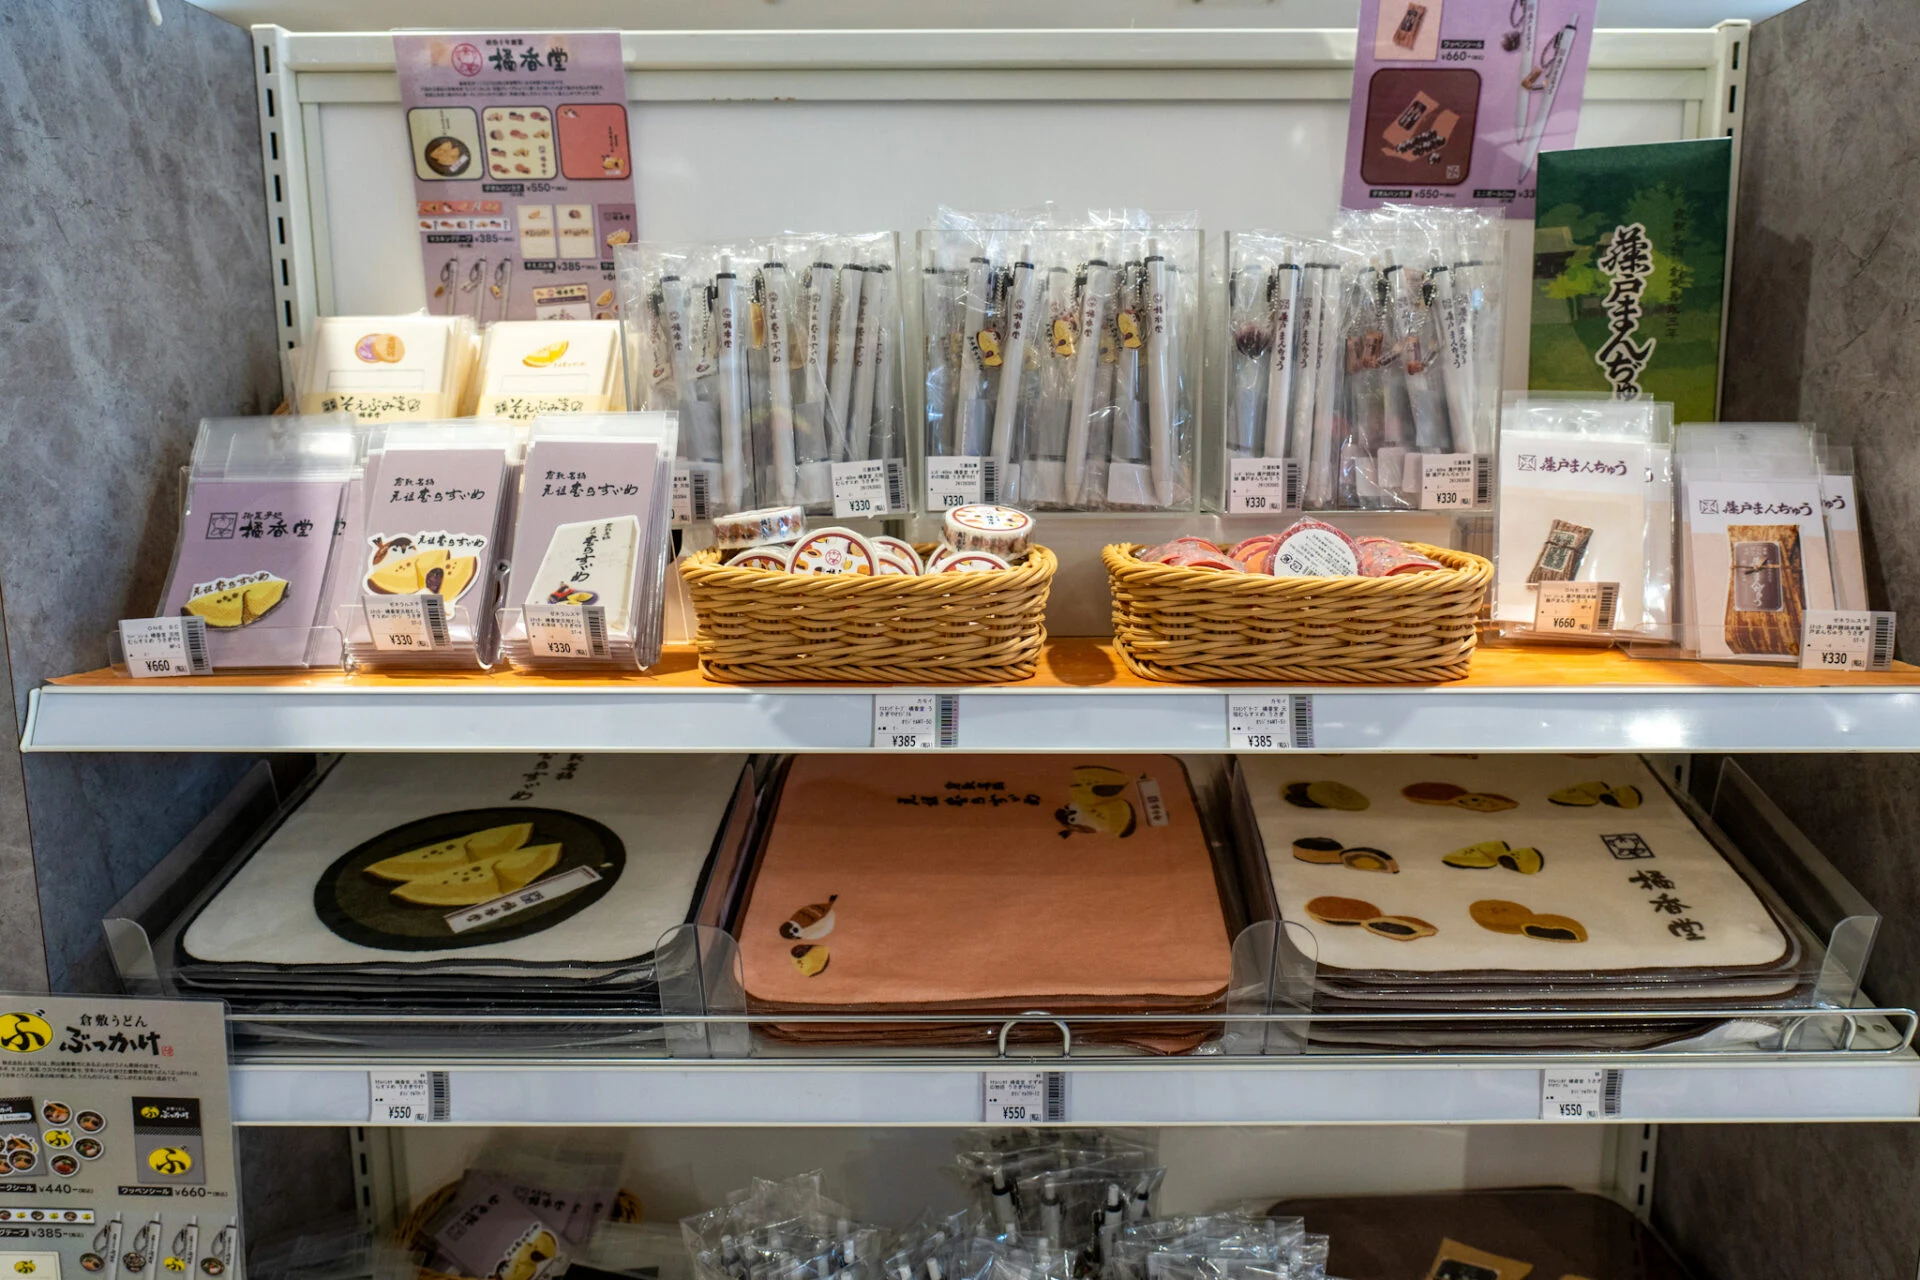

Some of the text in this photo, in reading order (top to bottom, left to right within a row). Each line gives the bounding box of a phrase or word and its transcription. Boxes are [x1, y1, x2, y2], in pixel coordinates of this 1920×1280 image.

[488, 46, 568, 72] 橘香堂
[943, 495, 964, 506] ¥330
[1245, 497, 1266, 508] ¥330
[1437, 492, 1457, 504] ¥330
[849, 500, 870, 511] ¥330
[239, 519, 313, 538] 橘香堂
[1553, 617, 1575, 628] ¥660
[389, 634, 412, 645] ¥330
[547, 642, 571, 653] ¥330
[1822, 652, 1847, 664] ¥330
[145, 659, 170, 671] ¥660
[892, 735, 916, 747] ¥385
[1248, 735, 1272, 747] ¥385
[1628, 870, 1706, 941] 橘香堂
[80, 1013, 147, 1028] 倉敷うどん
[59, 1026, 161, 1055] ぶっかけ
[389, 1106, 411, 1119] ¥550
[1003, 1106, 1026, 1119] ¥550
[1560, 1104, 1582, 1115] ¥550
[121, 1187, 170, 1195] ワッペンシール
